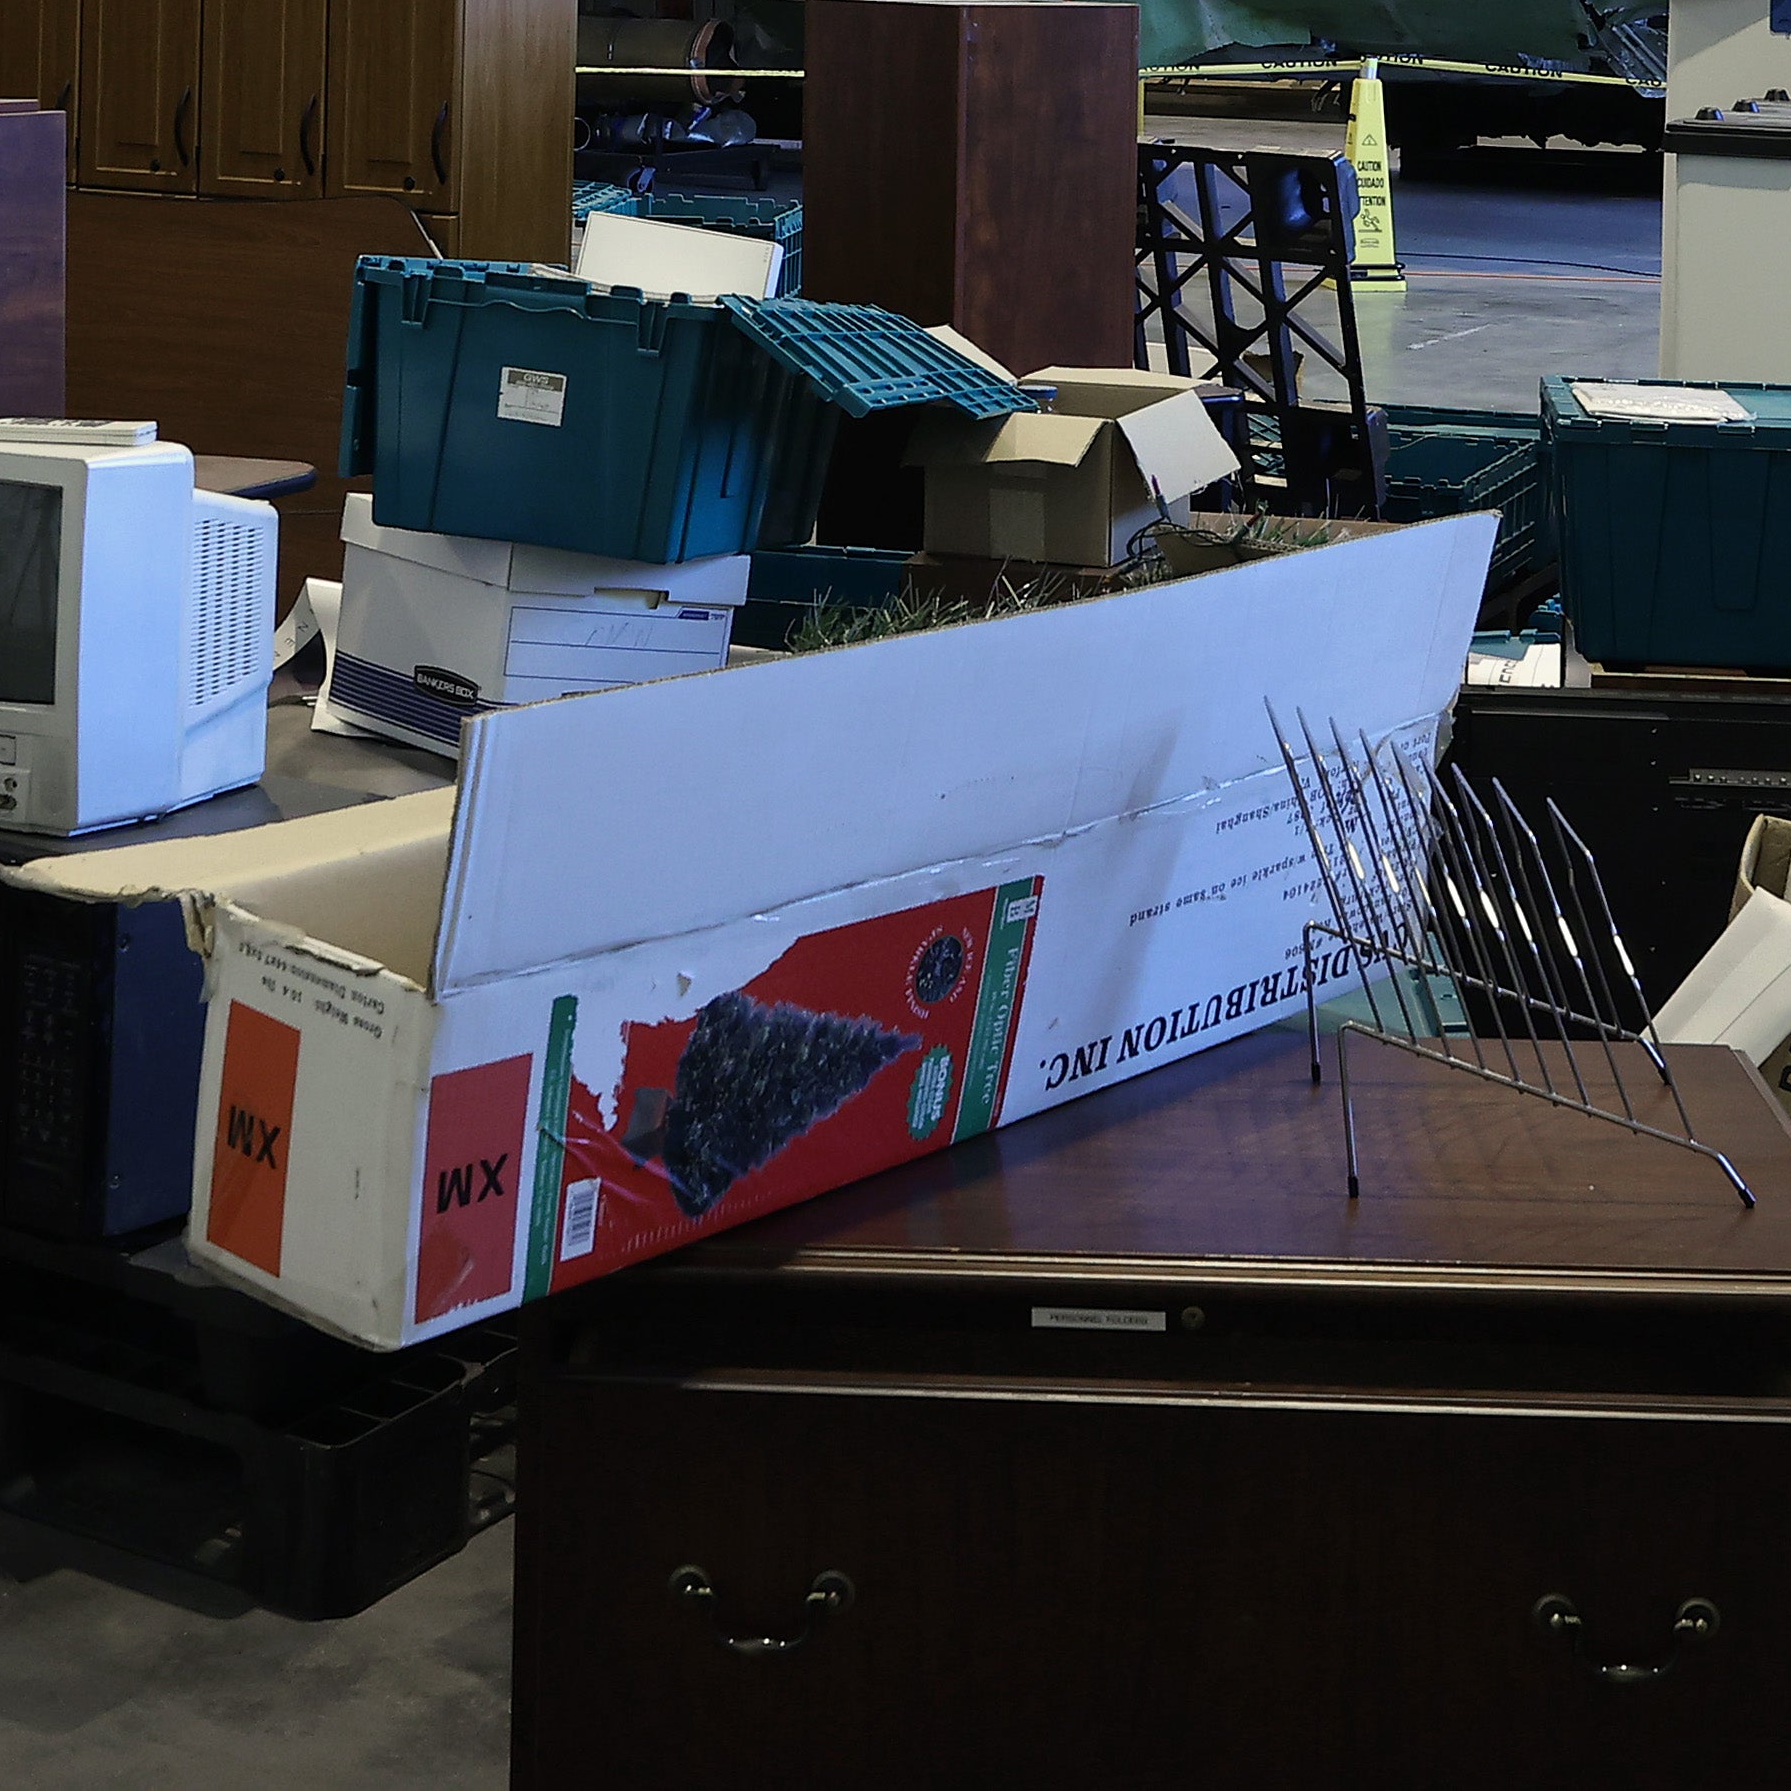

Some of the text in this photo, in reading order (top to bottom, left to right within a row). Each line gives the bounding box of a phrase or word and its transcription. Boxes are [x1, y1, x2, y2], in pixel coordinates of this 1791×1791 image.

[1140, 62, 1200, 73] AUTION
[1485, 62, 1563, 78] CAUTION
[1357, 160, 1382, 172] CAUTION
[416, 672, 475, 700] BANKERS BOX
[1215, 796, 1298, 833] hina/Shanghai
[1129, 854, 1306, 927] w/sparkle ice on same strand
[351, 989, 385, 1015] Carton
[1118, 944, 1352, 1063] DISTRIBUTION
[981, 946, 1019, 1105] Fiber Optic Tree
[1038, 1035, 1113, 1091] INC.
[929, 1054, 952, 1122] BONUS
[1048, 1313, 1149, 1326] PERSONNEL FOLDERS
